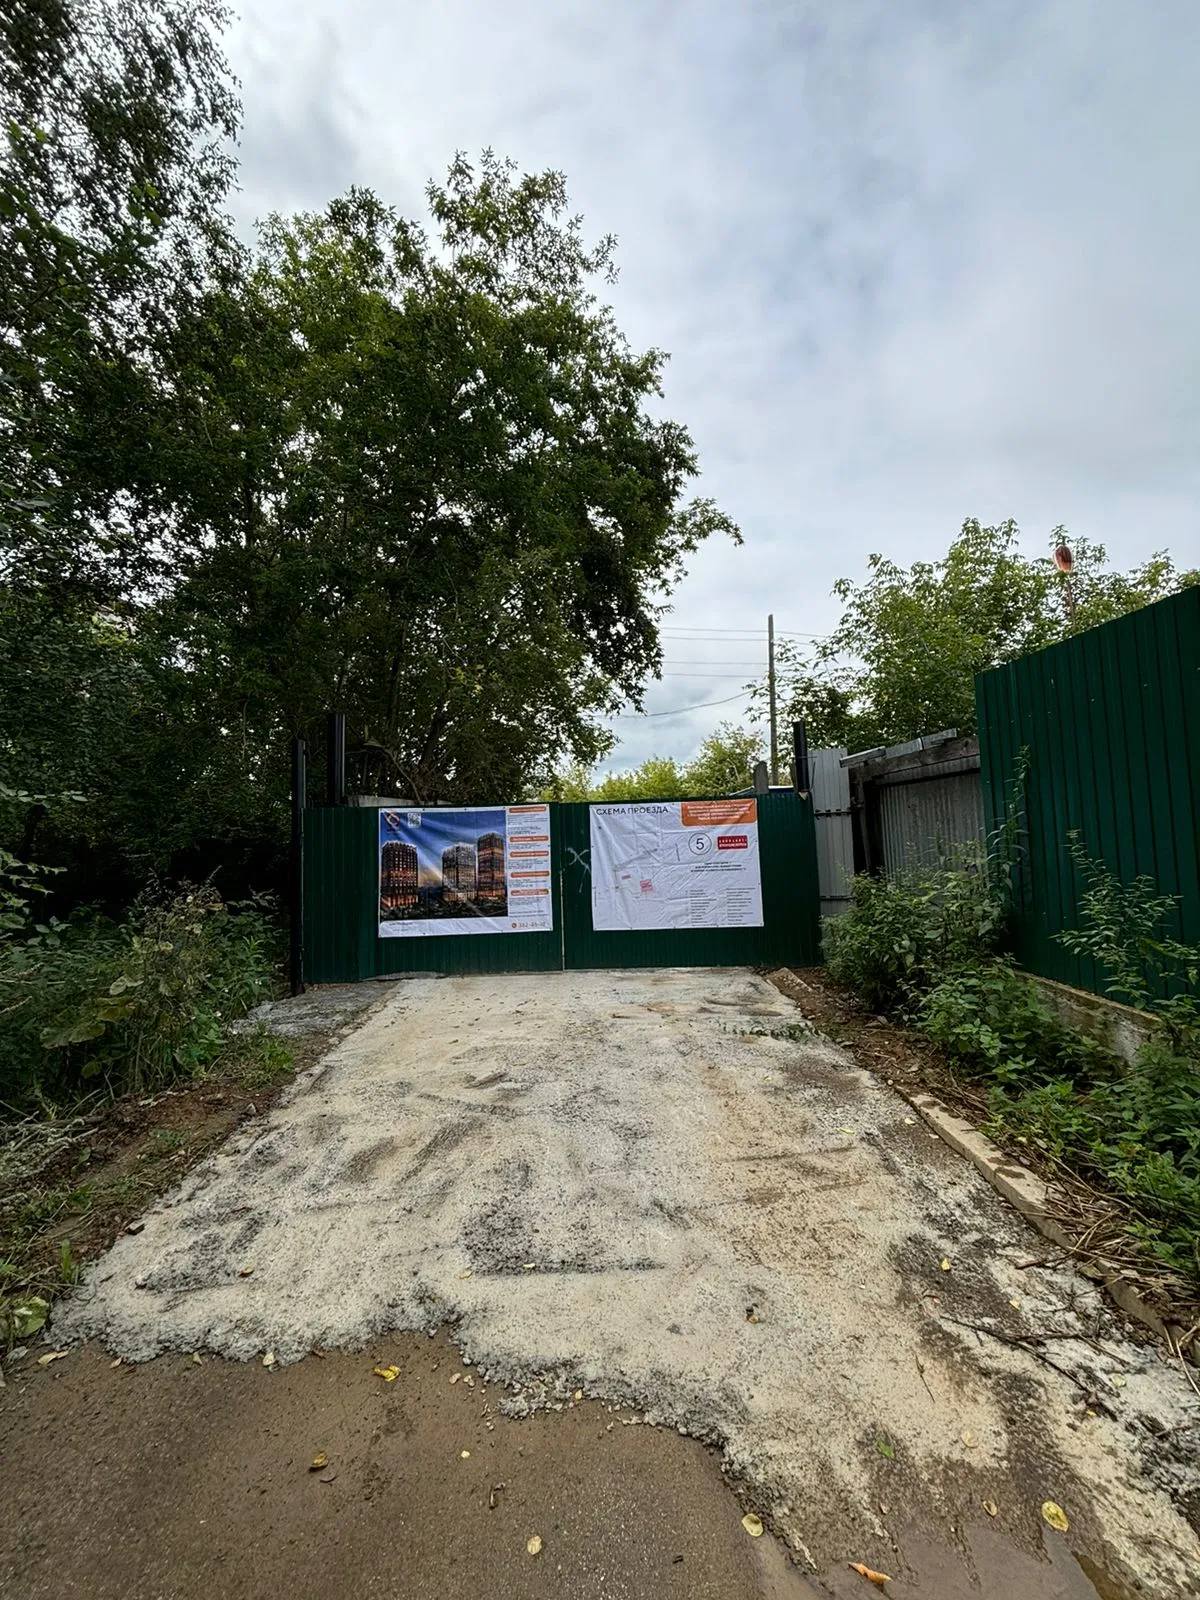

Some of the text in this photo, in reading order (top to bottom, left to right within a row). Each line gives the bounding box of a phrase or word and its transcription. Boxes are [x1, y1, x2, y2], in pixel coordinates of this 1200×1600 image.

[596, 806, 669, 816] СХЕМА ПРОЕЗДА
[696, 838, 704, 850] 5
